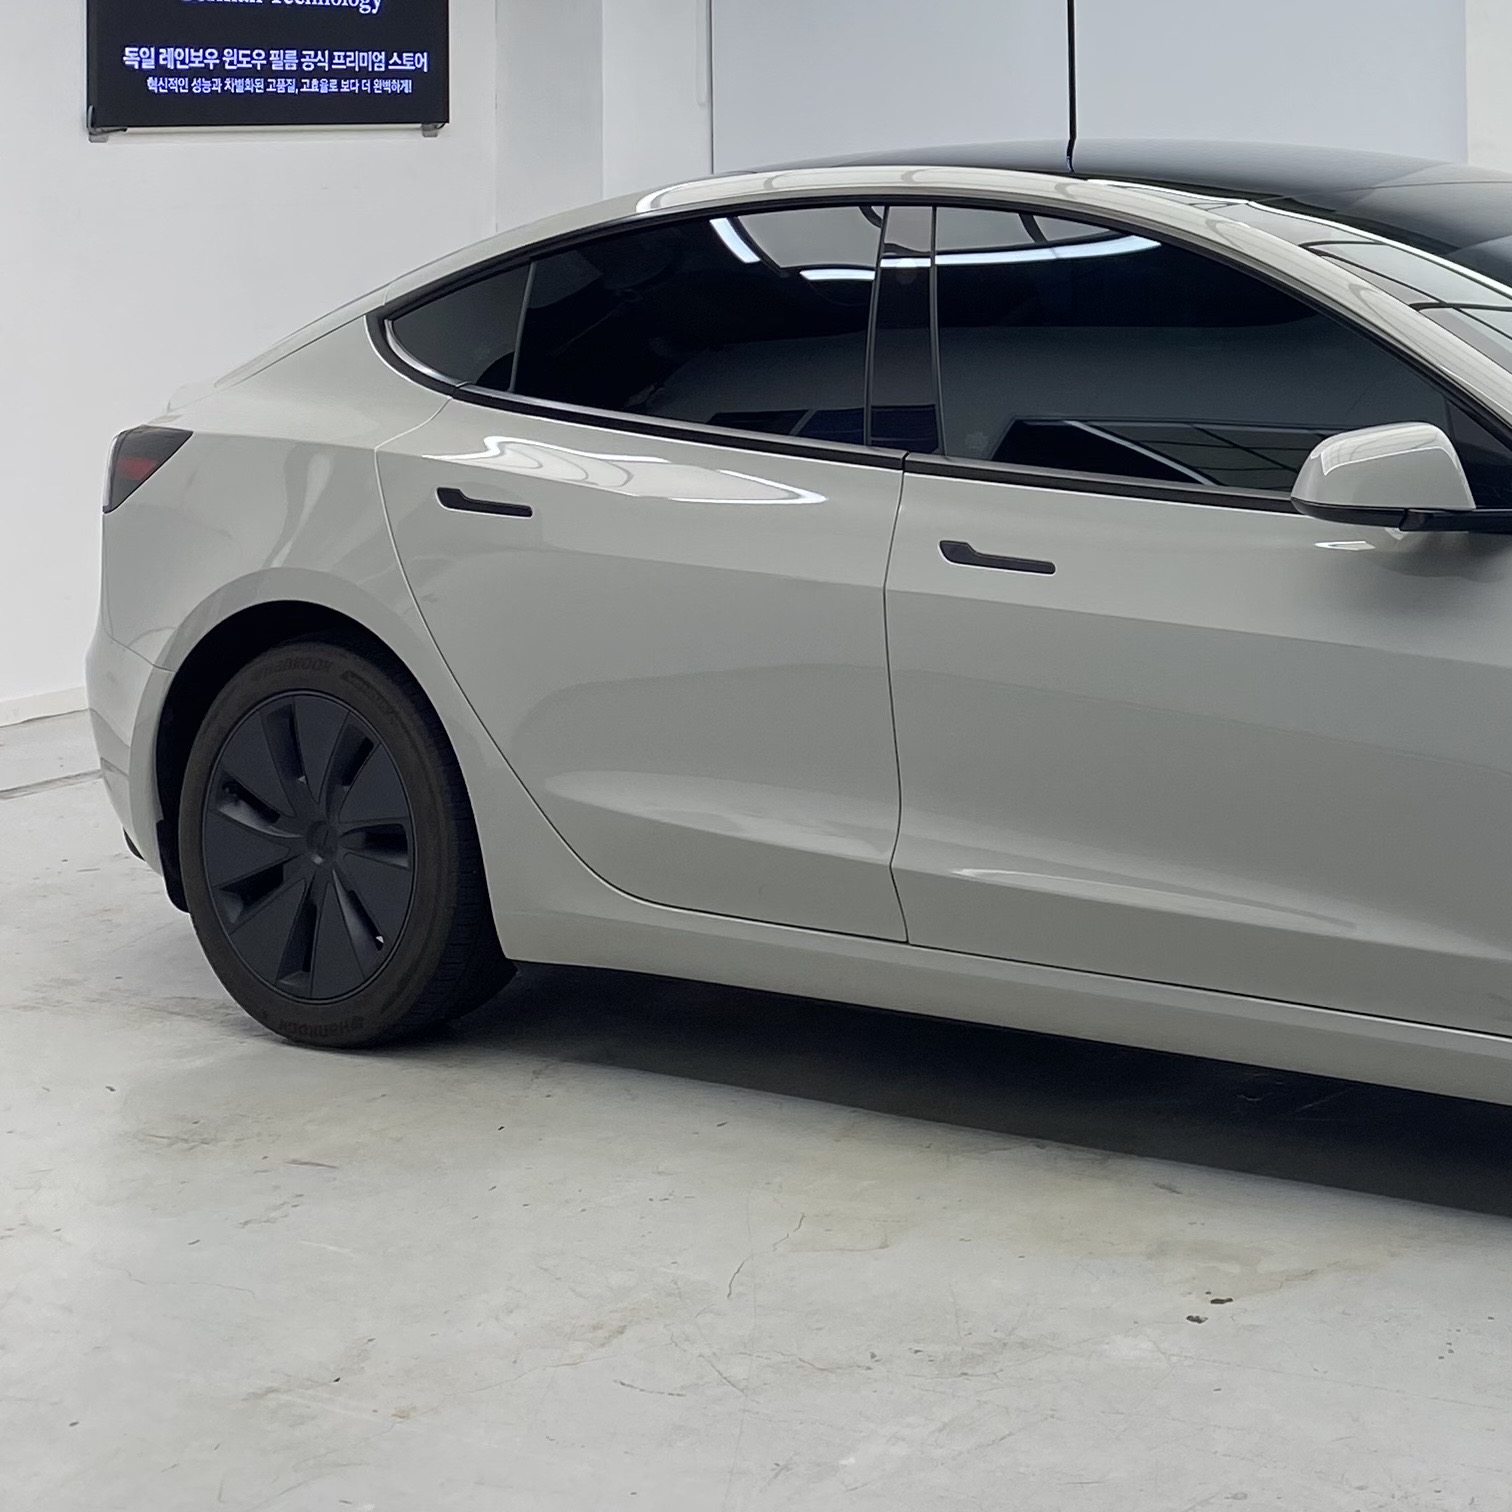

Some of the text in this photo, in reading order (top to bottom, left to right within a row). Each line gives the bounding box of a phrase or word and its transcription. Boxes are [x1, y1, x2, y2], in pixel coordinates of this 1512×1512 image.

[123, 46, 428, 73] 독일 레인보우 윈도우 필름 공식 프리미엄 스토어
[147, 77, 413, 95] 혁신적인 성능과 차별화된 고품질, 고효율로 보다 더 완벽하게!
